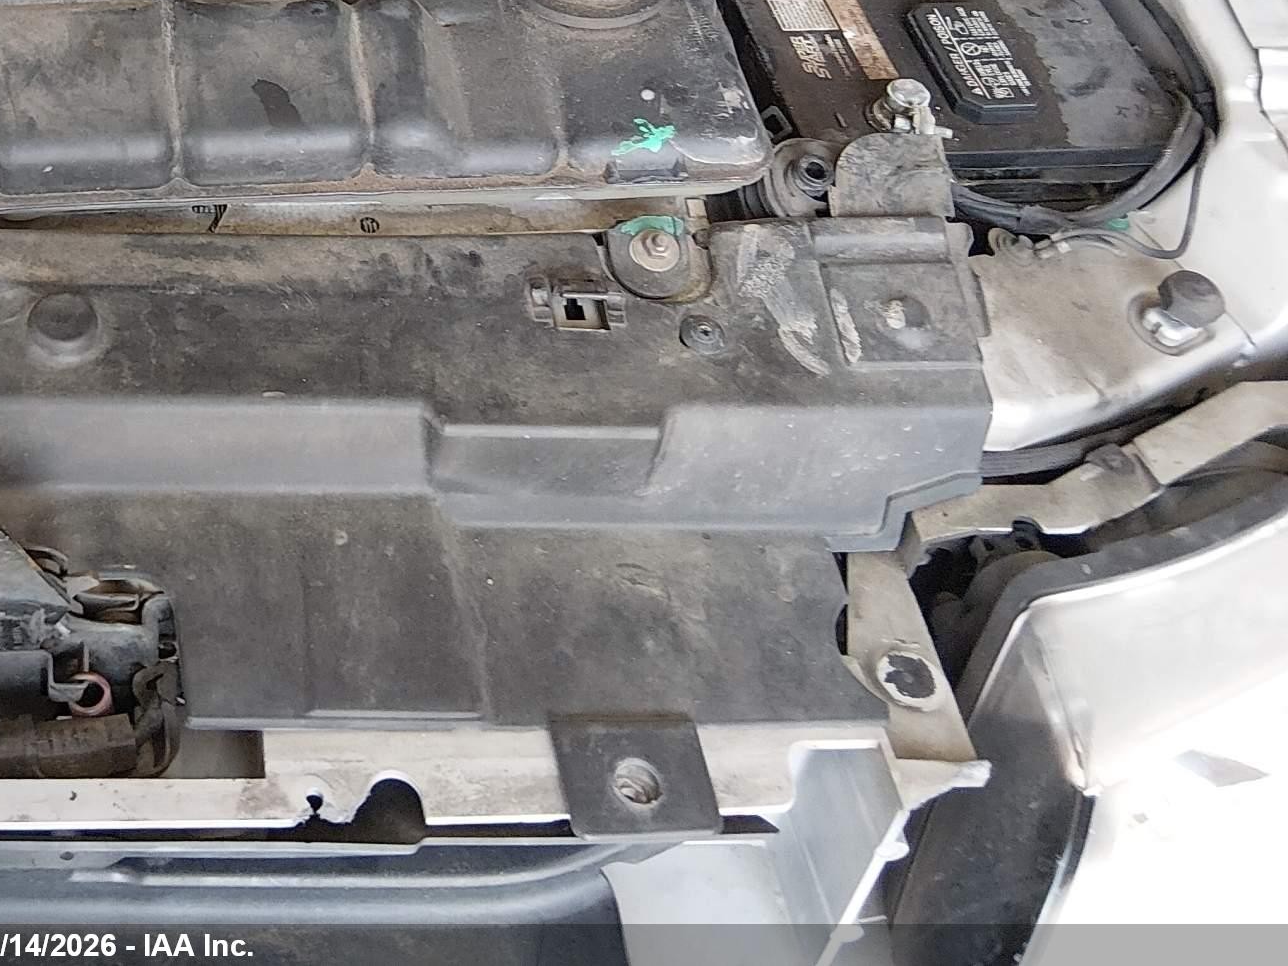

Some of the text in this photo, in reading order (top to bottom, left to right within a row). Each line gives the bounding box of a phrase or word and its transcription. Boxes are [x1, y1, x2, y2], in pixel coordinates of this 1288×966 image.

[926, 14, 953, 45] POISON
[789, 35, 814, 74] SUPER
[804, 38, 832, 79] START
[948, 54, 977, 87] DANGER
